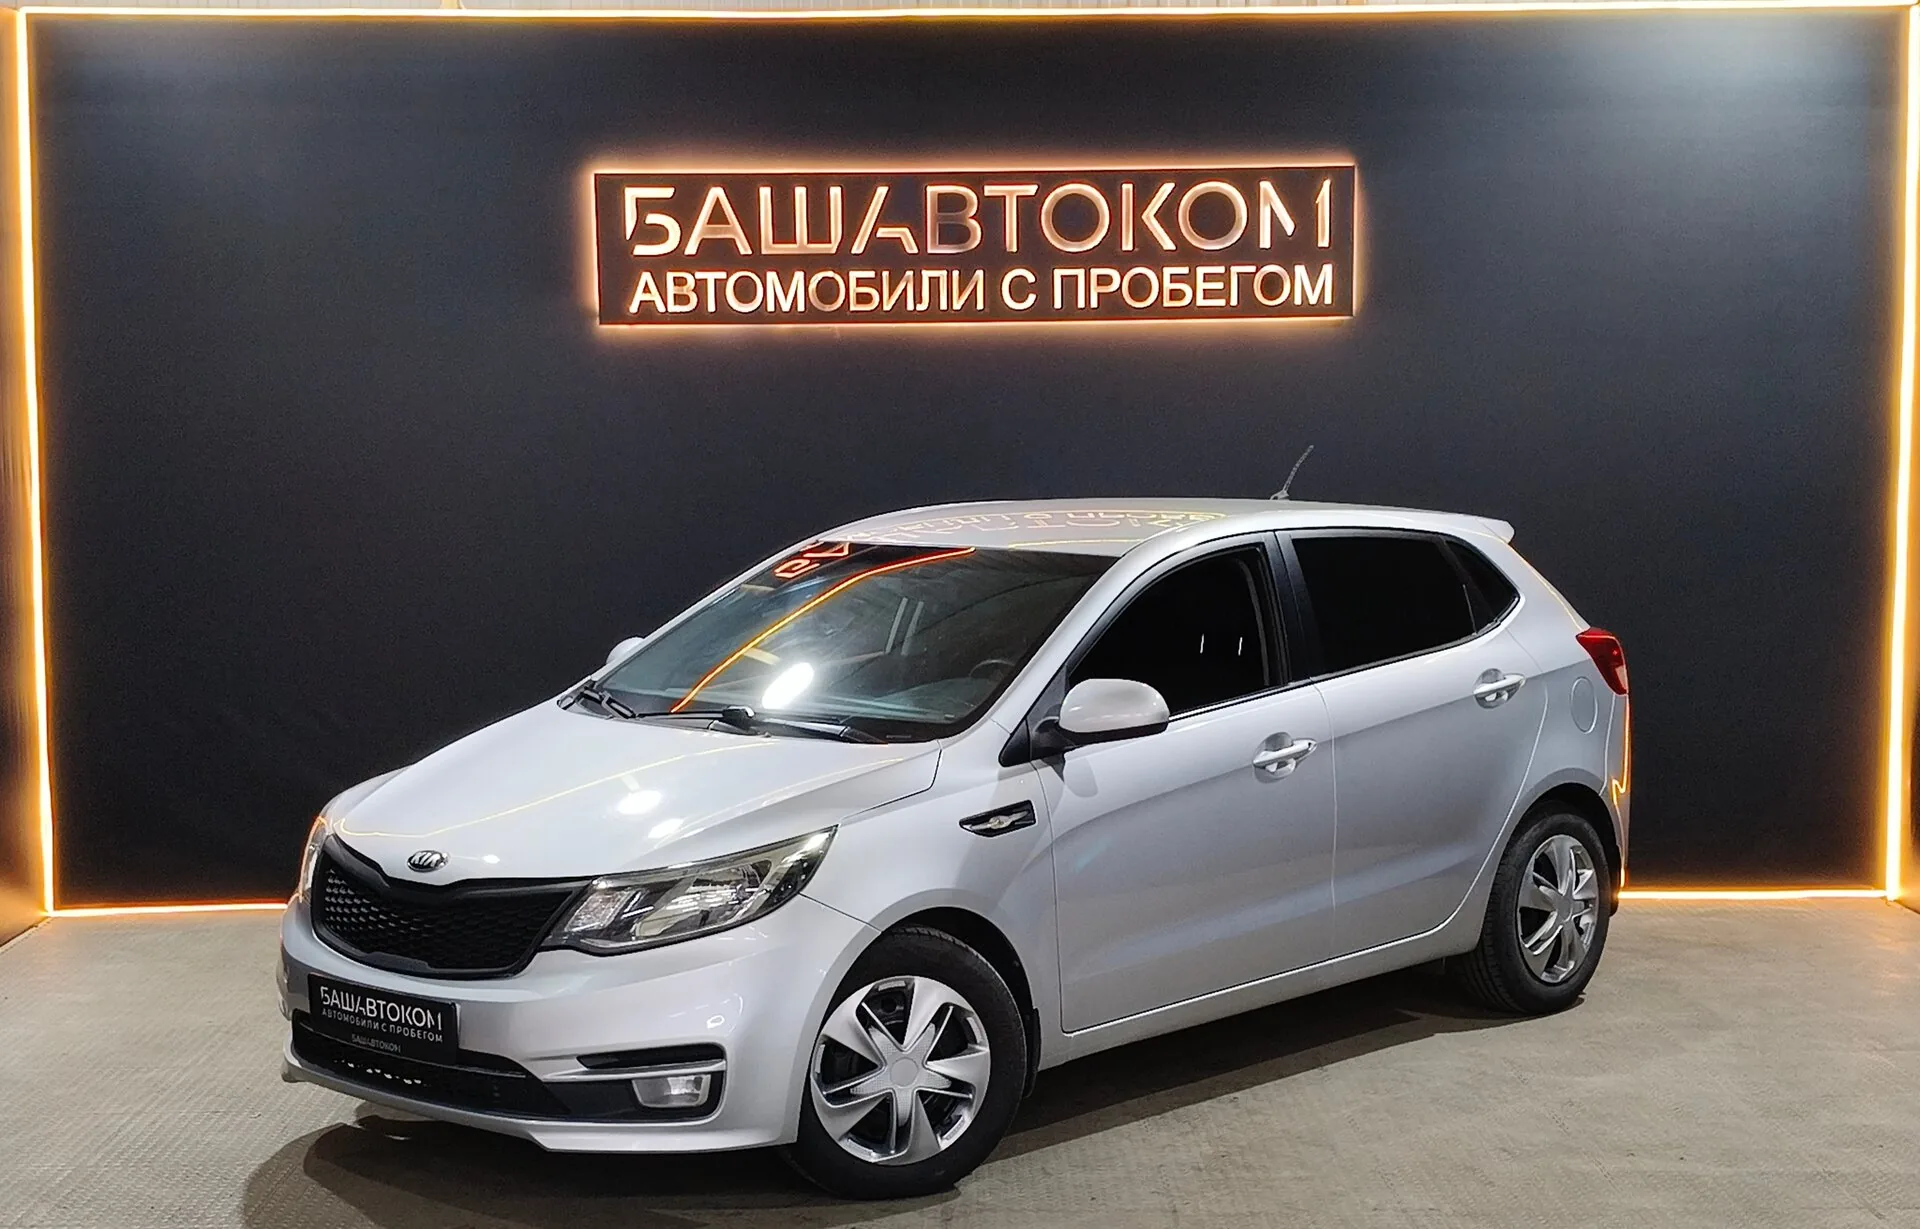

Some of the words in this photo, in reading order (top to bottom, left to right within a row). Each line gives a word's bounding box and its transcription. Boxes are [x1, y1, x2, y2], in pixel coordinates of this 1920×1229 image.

[623, 180, 1332, 256] БАШАВТОКОМ
[629, 269, 986, 314] АВТОМОБИЛИ
[1001, 267, 1037, 311] С
[1052, 263, 1334, 310] ПРОБЕГОМ
[320, 986, 442, 1031] БАШАВТОКОМ
[322, 1009, 380, 1031] АВТОМОБИЛИ
[381, 1023, 388, 1032] С
[389, 1024, 443, 1043] ПРОБЕГОМ
